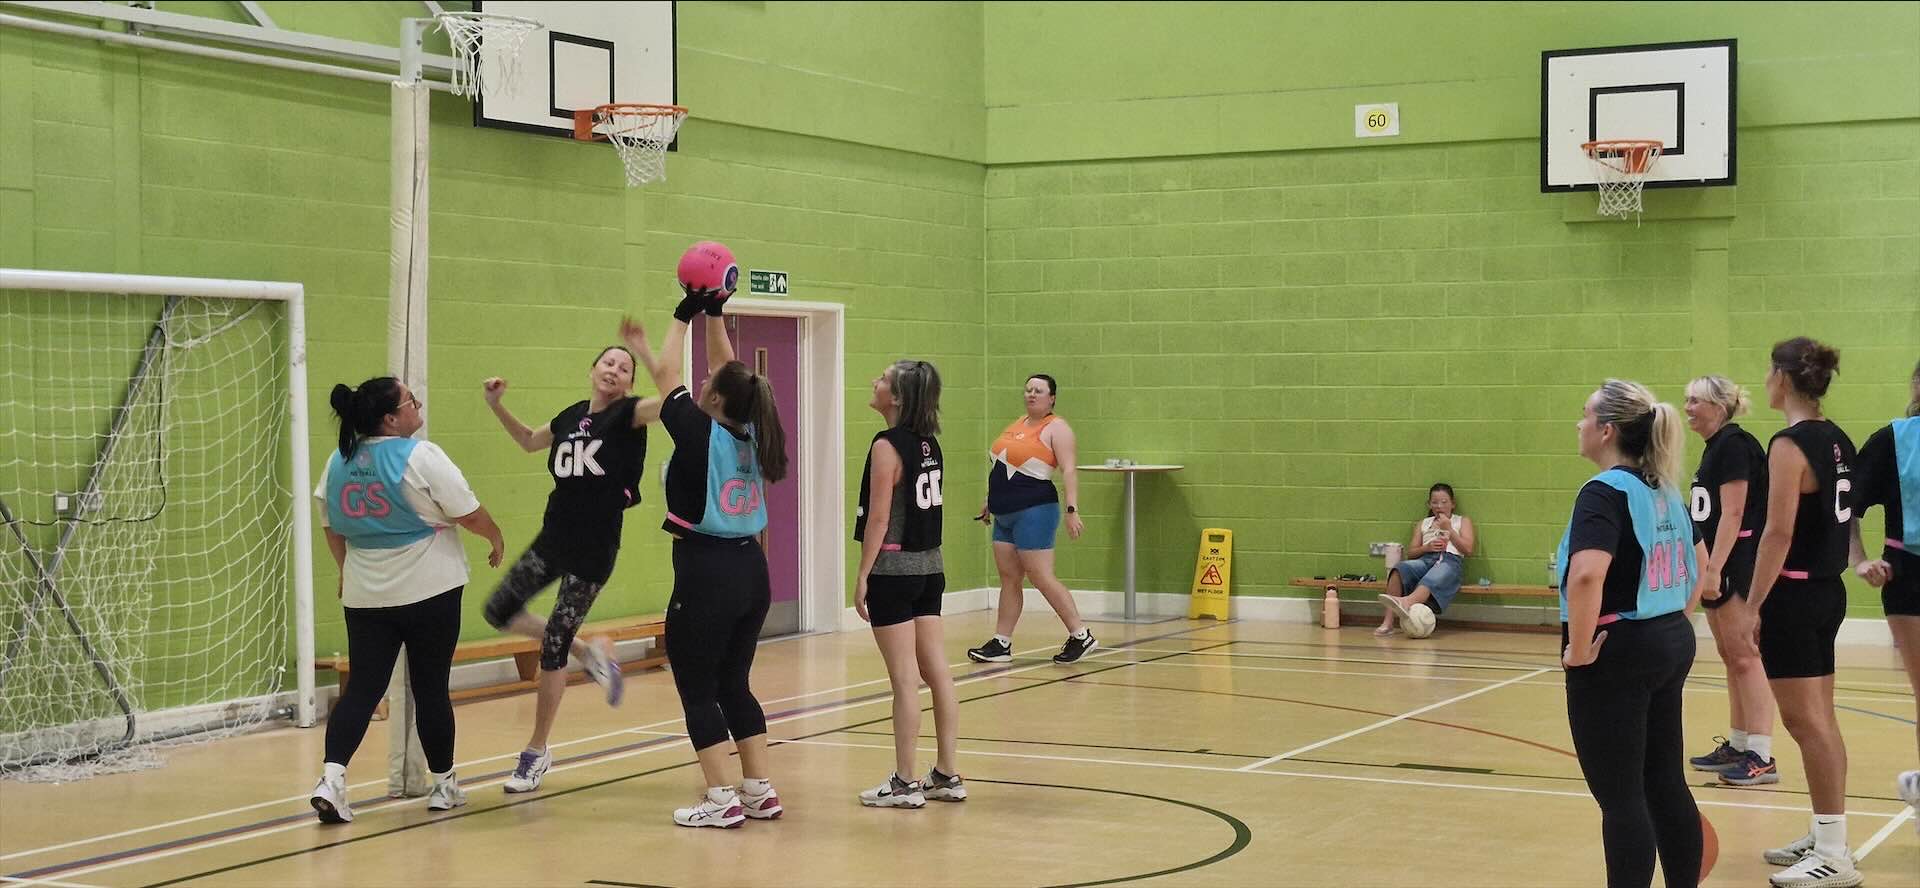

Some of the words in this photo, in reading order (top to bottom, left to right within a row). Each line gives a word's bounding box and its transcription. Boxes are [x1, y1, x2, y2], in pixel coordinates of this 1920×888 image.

[1368, 113, 1386, 128] 60
[554, 439, 606, 478] GK
[340, 481, 392, 518] GS
[720, 478, 760, 517] GA
[1835, 478, 1852, 523] C
[1647, 537, 1690, 592] WA
